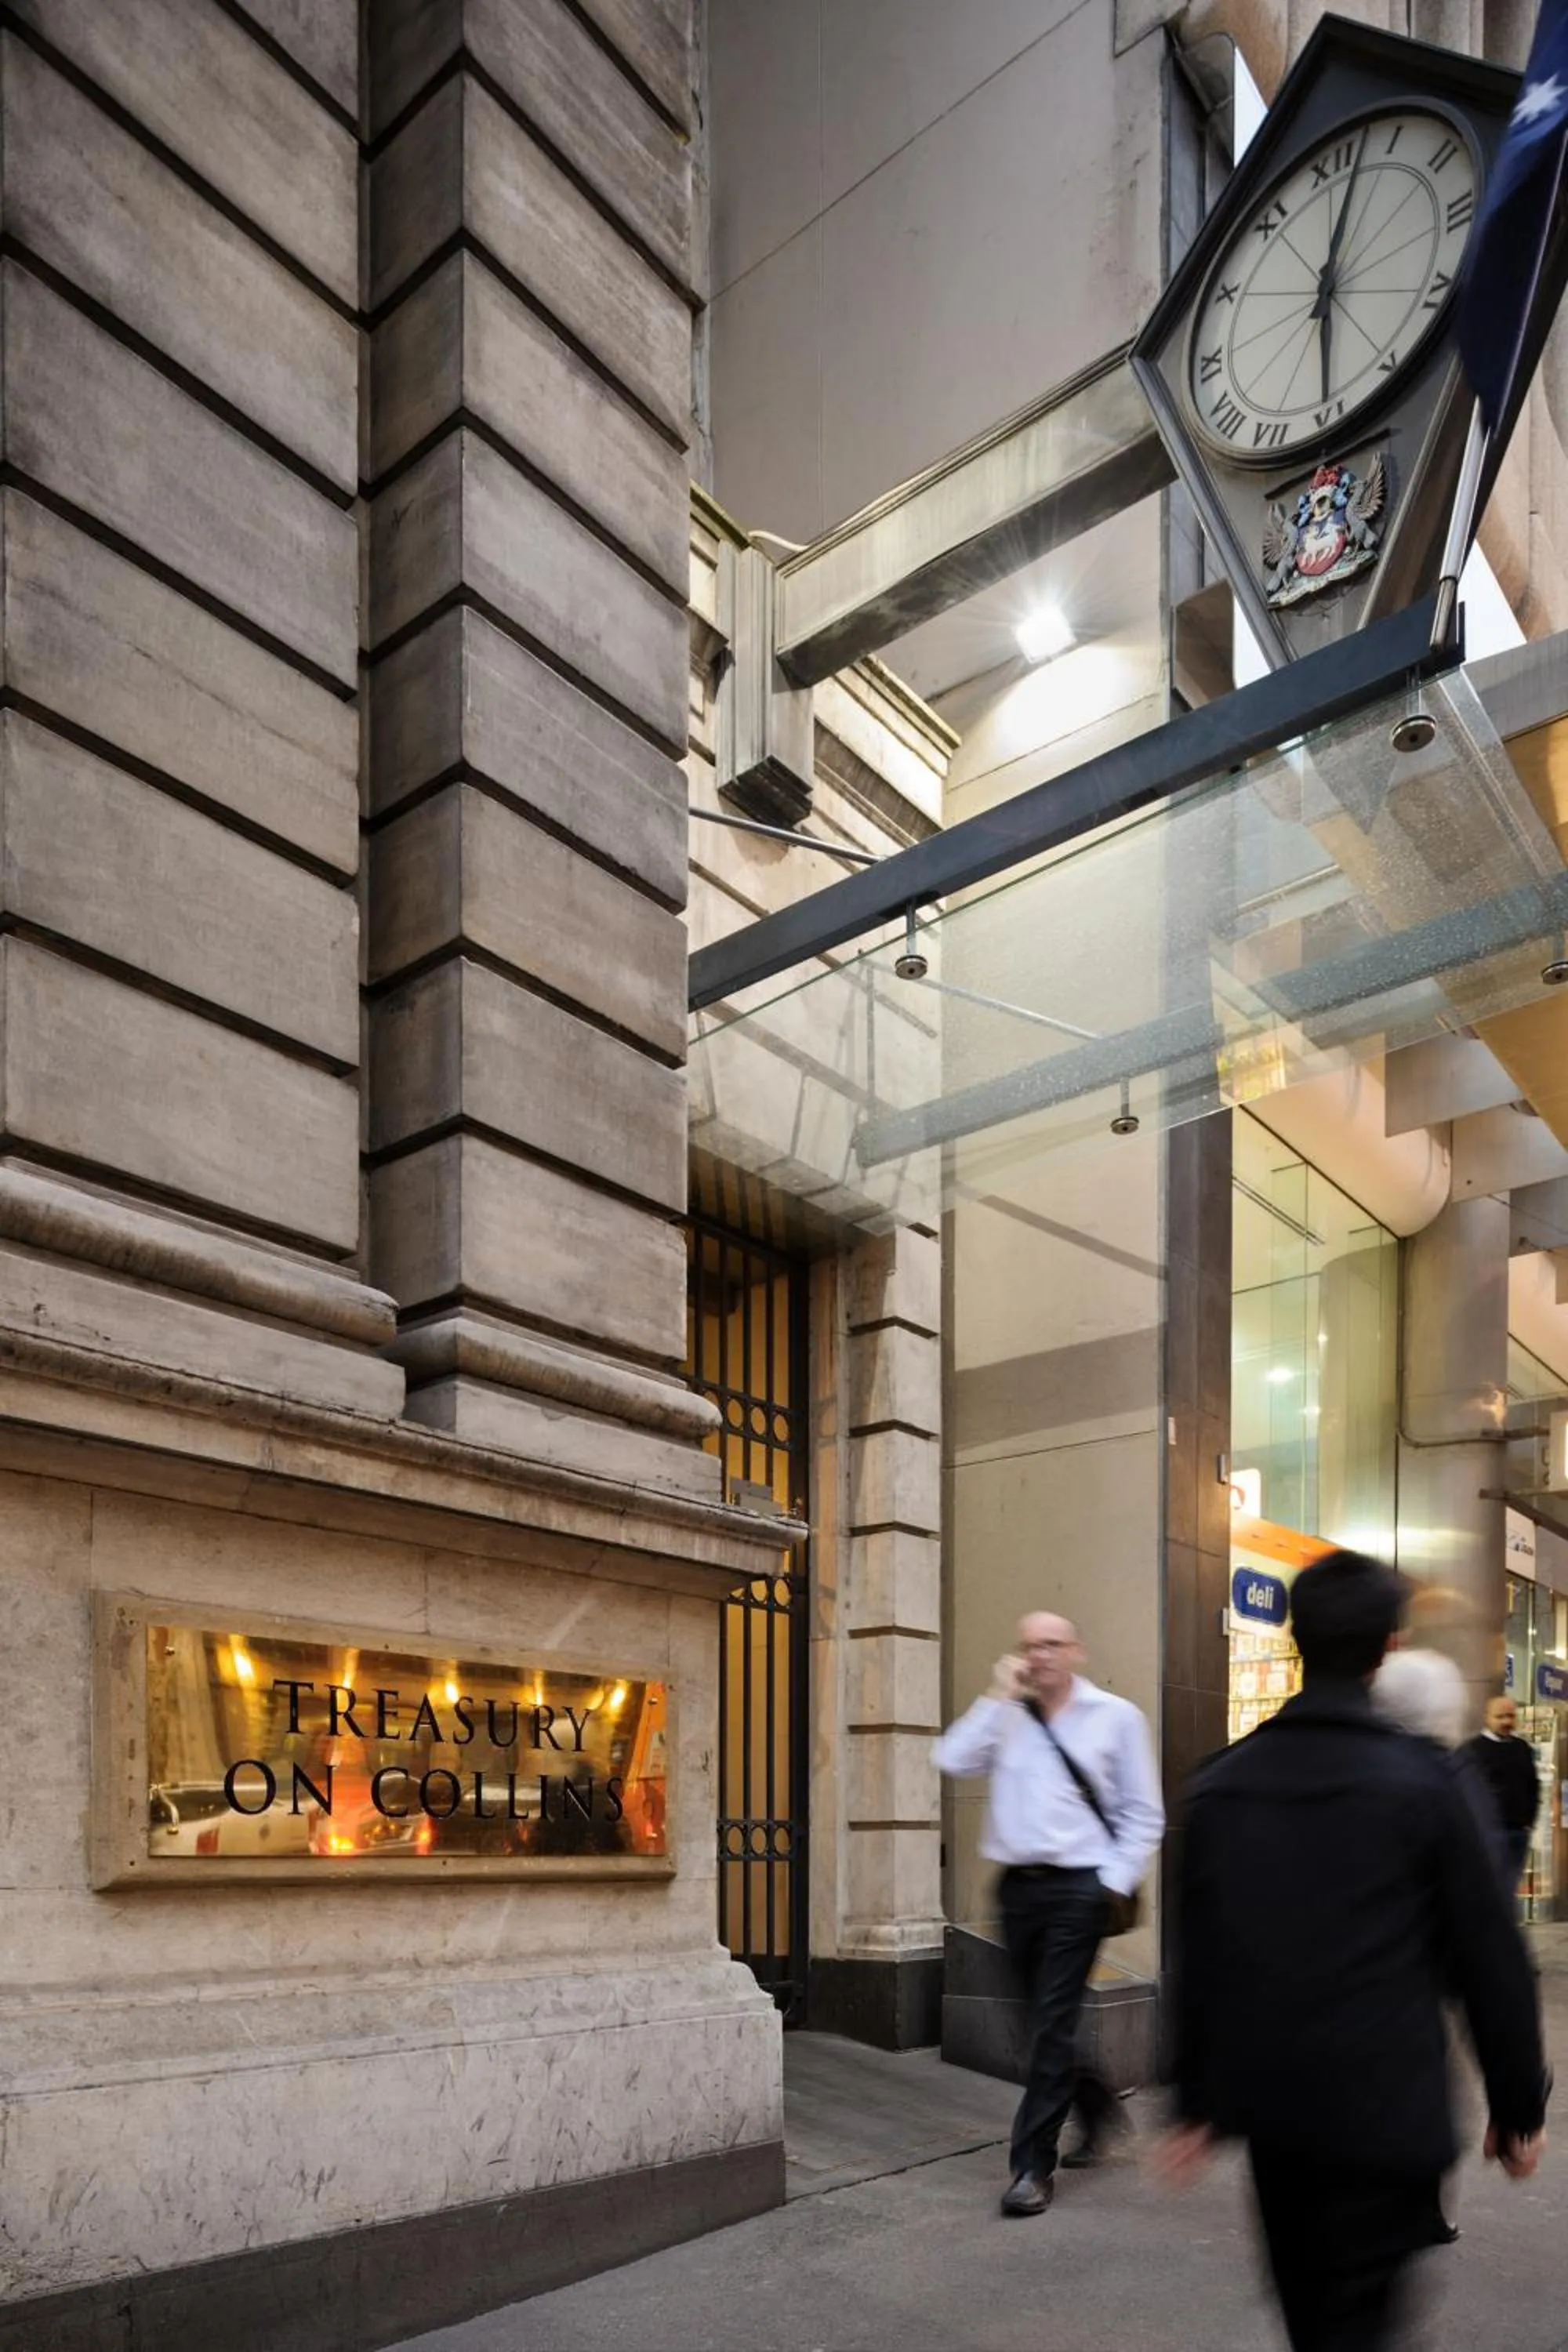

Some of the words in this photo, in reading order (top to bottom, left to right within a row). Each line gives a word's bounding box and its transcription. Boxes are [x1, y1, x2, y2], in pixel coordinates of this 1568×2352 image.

[1310, 140, 1355, 191] XII
[1428, 138, 1458, 174] II
[1254, 200, 1289, 241] XI
[1215, 281, 1241, 305] X
[1210, 391, 1247, 441] VIII
[1253, 422, 1289, 448] VII
[1247, 1581, 1275, 1610] deli
[272, 1678, 593, 1754] TREASURY
[223, 1759, 336, 1817] ON
[370, 1766, 626, 1823] COLLINS
